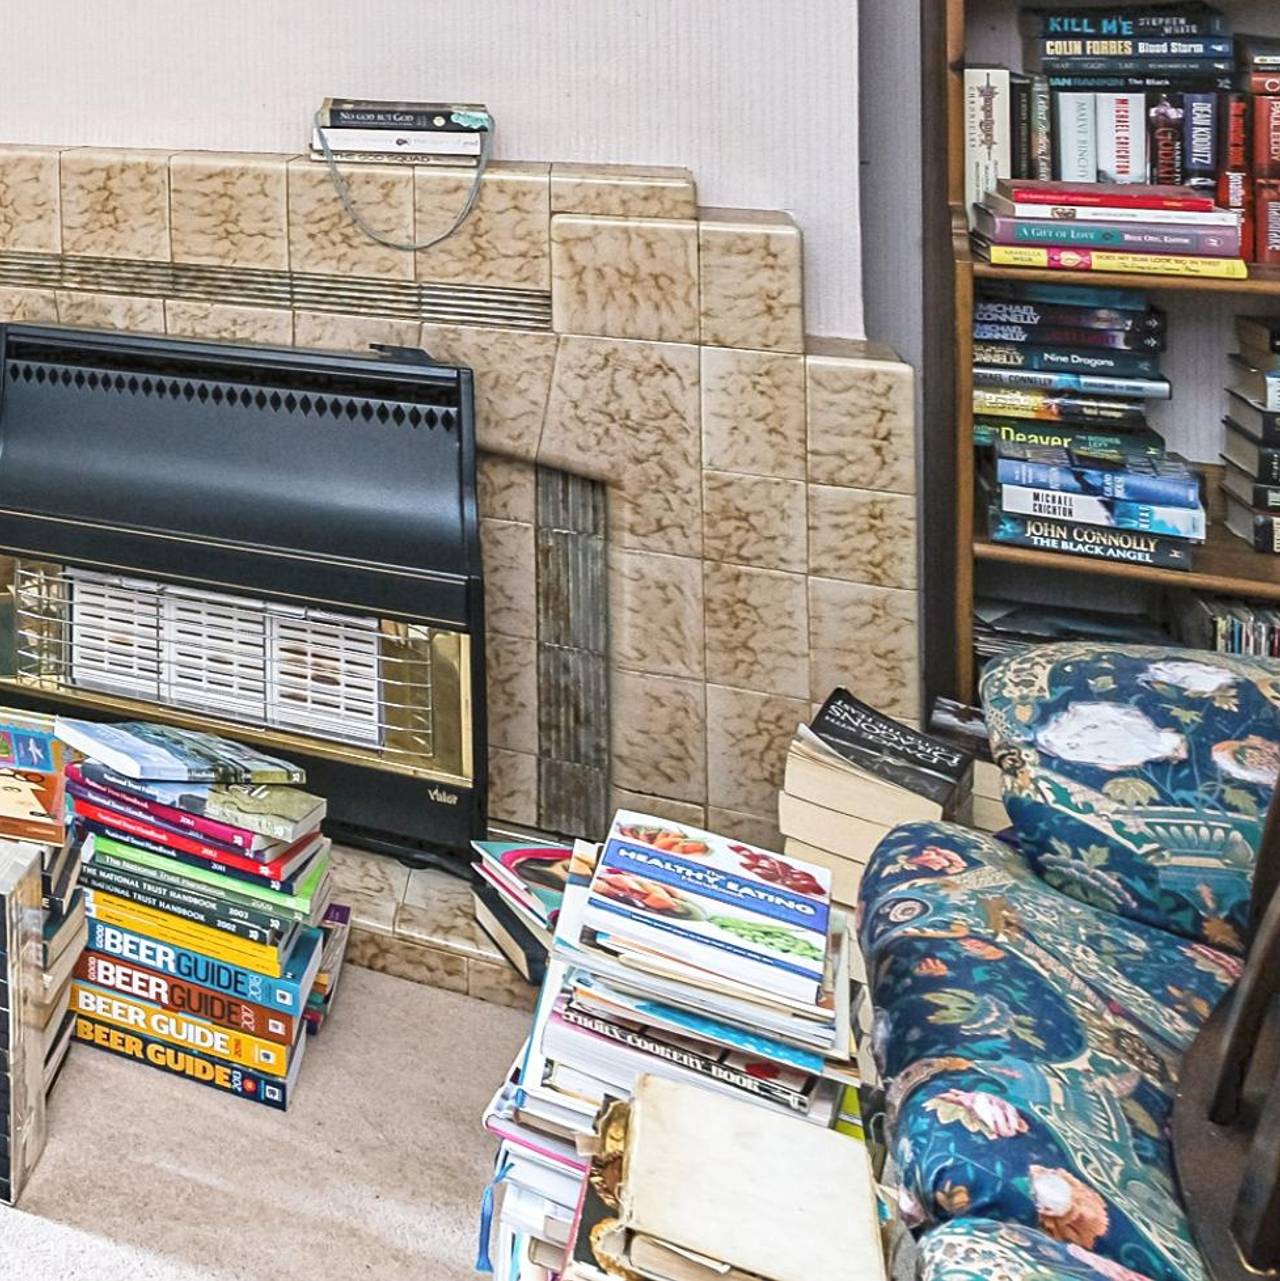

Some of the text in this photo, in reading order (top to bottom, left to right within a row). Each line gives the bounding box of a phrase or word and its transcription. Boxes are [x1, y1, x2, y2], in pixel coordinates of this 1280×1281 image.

[1049, 17, 1134, 34] KILL ME
[1046, 40, 1204, 55] COLIN FORBES Blood Storm
[1049, 78, 1170, 86] IAN The Black
[1077, 101, 1088, 179] MAEVE BINCHY
[1114, 98, 1130, 175] MICHAEL CRICHTON
[1192, 102, 1211, 164] DEAN KOONTZ
[390, 155, 430, 163] SQUAD
[976, 312, 1040, 324] CONNELLY
[977, 304, 1035, 316] MICHAEL
[974, 324, 1023, 335] MICHAEL
[974, 331, 1028, 342] CONNELLY
[1043, 353, 1114, 368] Nine Dragons
[1009, 373, 1053, 386] CONNELLY
[1001, 426, 1072, 447] Deaver
[1032, 492, 1073, 507] MICHAEL
[1032, 502, 1074, 518] CRICHTON
[1024, 521, 1158, 553] JOHN CONNOLLY
[1031, 536, 1154, 563] THE BLACK ANGEL
[828, 705, 962, 767] DRAGONS
[105, 856, 121, 866] The
[82, 865, 98, 876] THE
[100, 870, 139, 888] NATIONAL
[143, 880, 168, 896] TRUST
[170, 887, 217, 910] HANDBOOK
[619, 847, 816, 917] HEALTHY EATING
[92, 878, 130, 898] NATIONAL
[133, 892, 157, 907] TRUST
[159, 899, 206, 921] HANDBOOK
[105, 927, 177, 975] BEER
[175, 952, 248, 996] GUIDE
[248, 975, 263, 1001] 2018
[96, 957, 169, 1004] BEER
[168, 983, 240, 1027] GUIDE
[240, 1005, 256, 1032] 2017
[78, 990, 231, 1055] BEER GUIDE
[77, 1019, 232, 1090] BEER GUIDE
[626, 1035, 762, 1093] COOKERY BOOK
